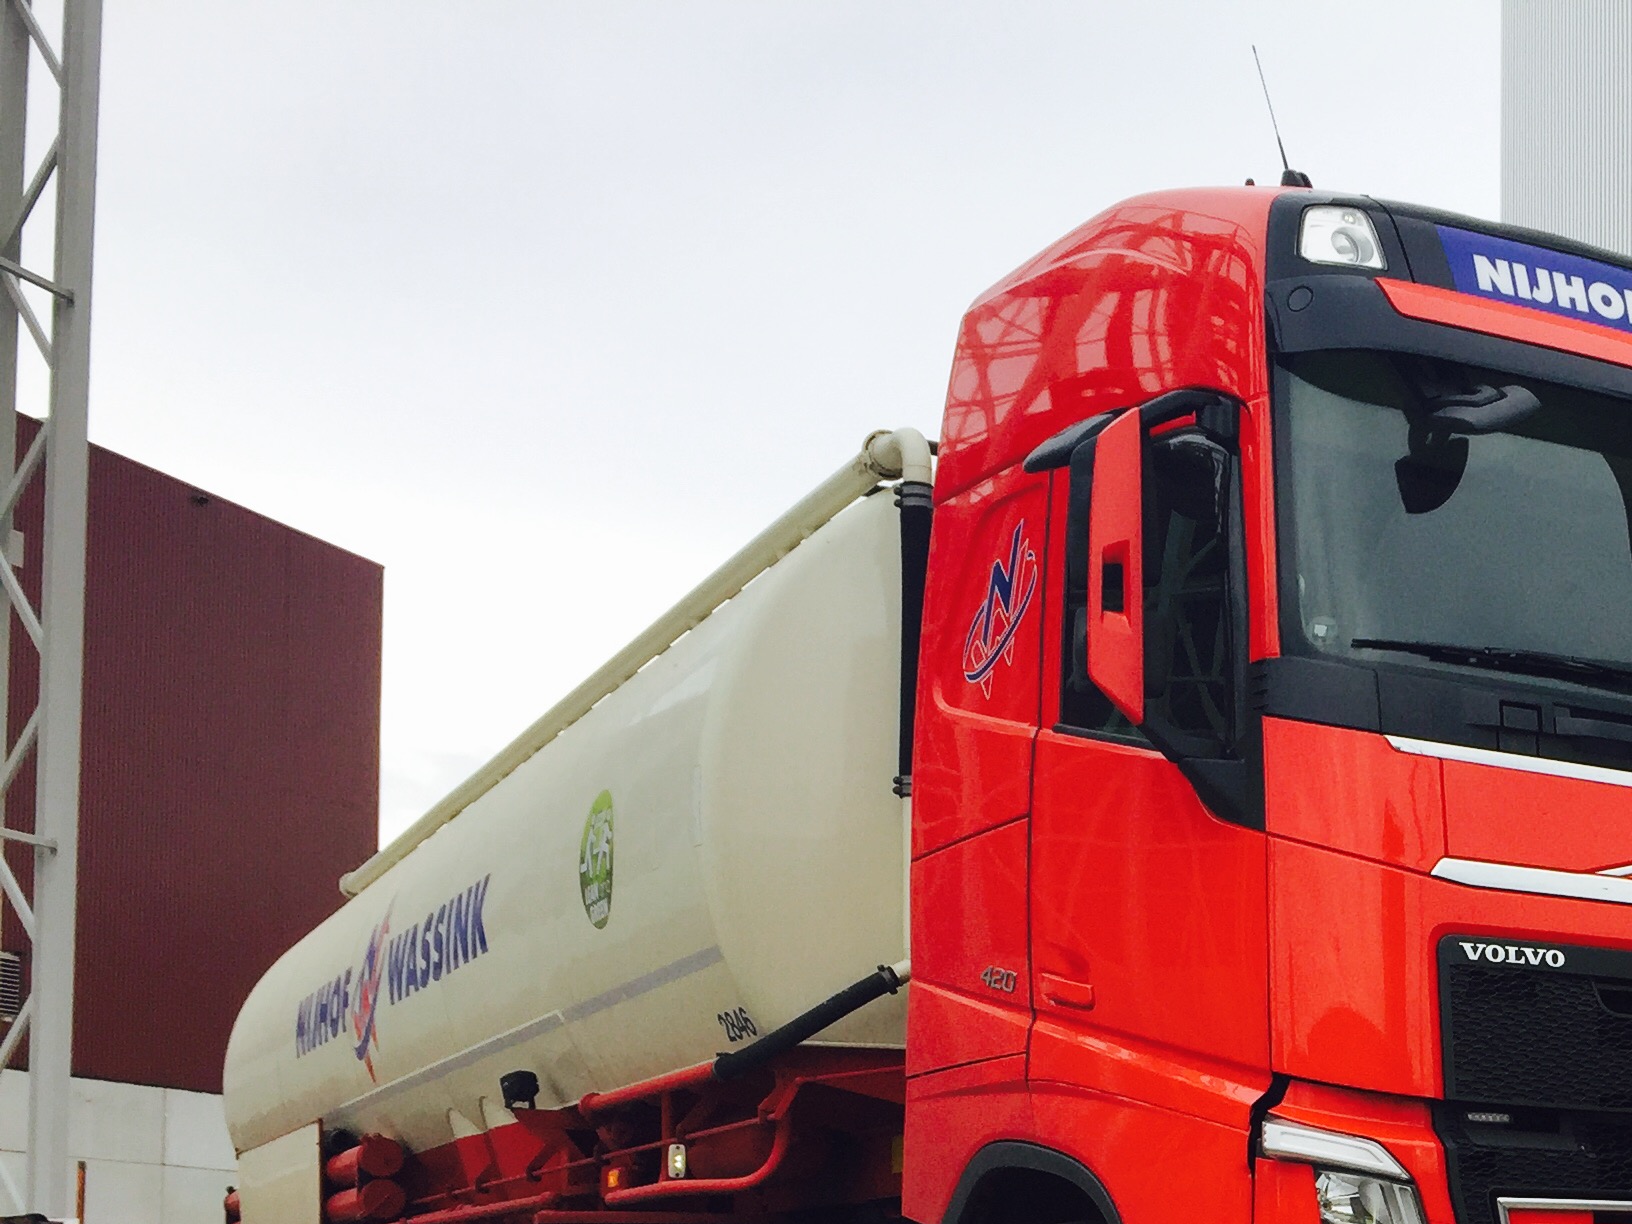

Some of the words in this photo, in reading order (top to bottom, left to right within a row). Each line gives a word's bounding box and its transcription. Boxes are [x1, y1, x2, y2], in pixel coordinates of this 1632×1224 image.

[296, 965, 353, 1060] NIJHOF
[388, 873, 491, 1006] WASSINK
[1458, 941, 1566, 968] VOLVO
[981, 965, 1018, 994] 420
[717, 1006, 758, 1042] 2846
